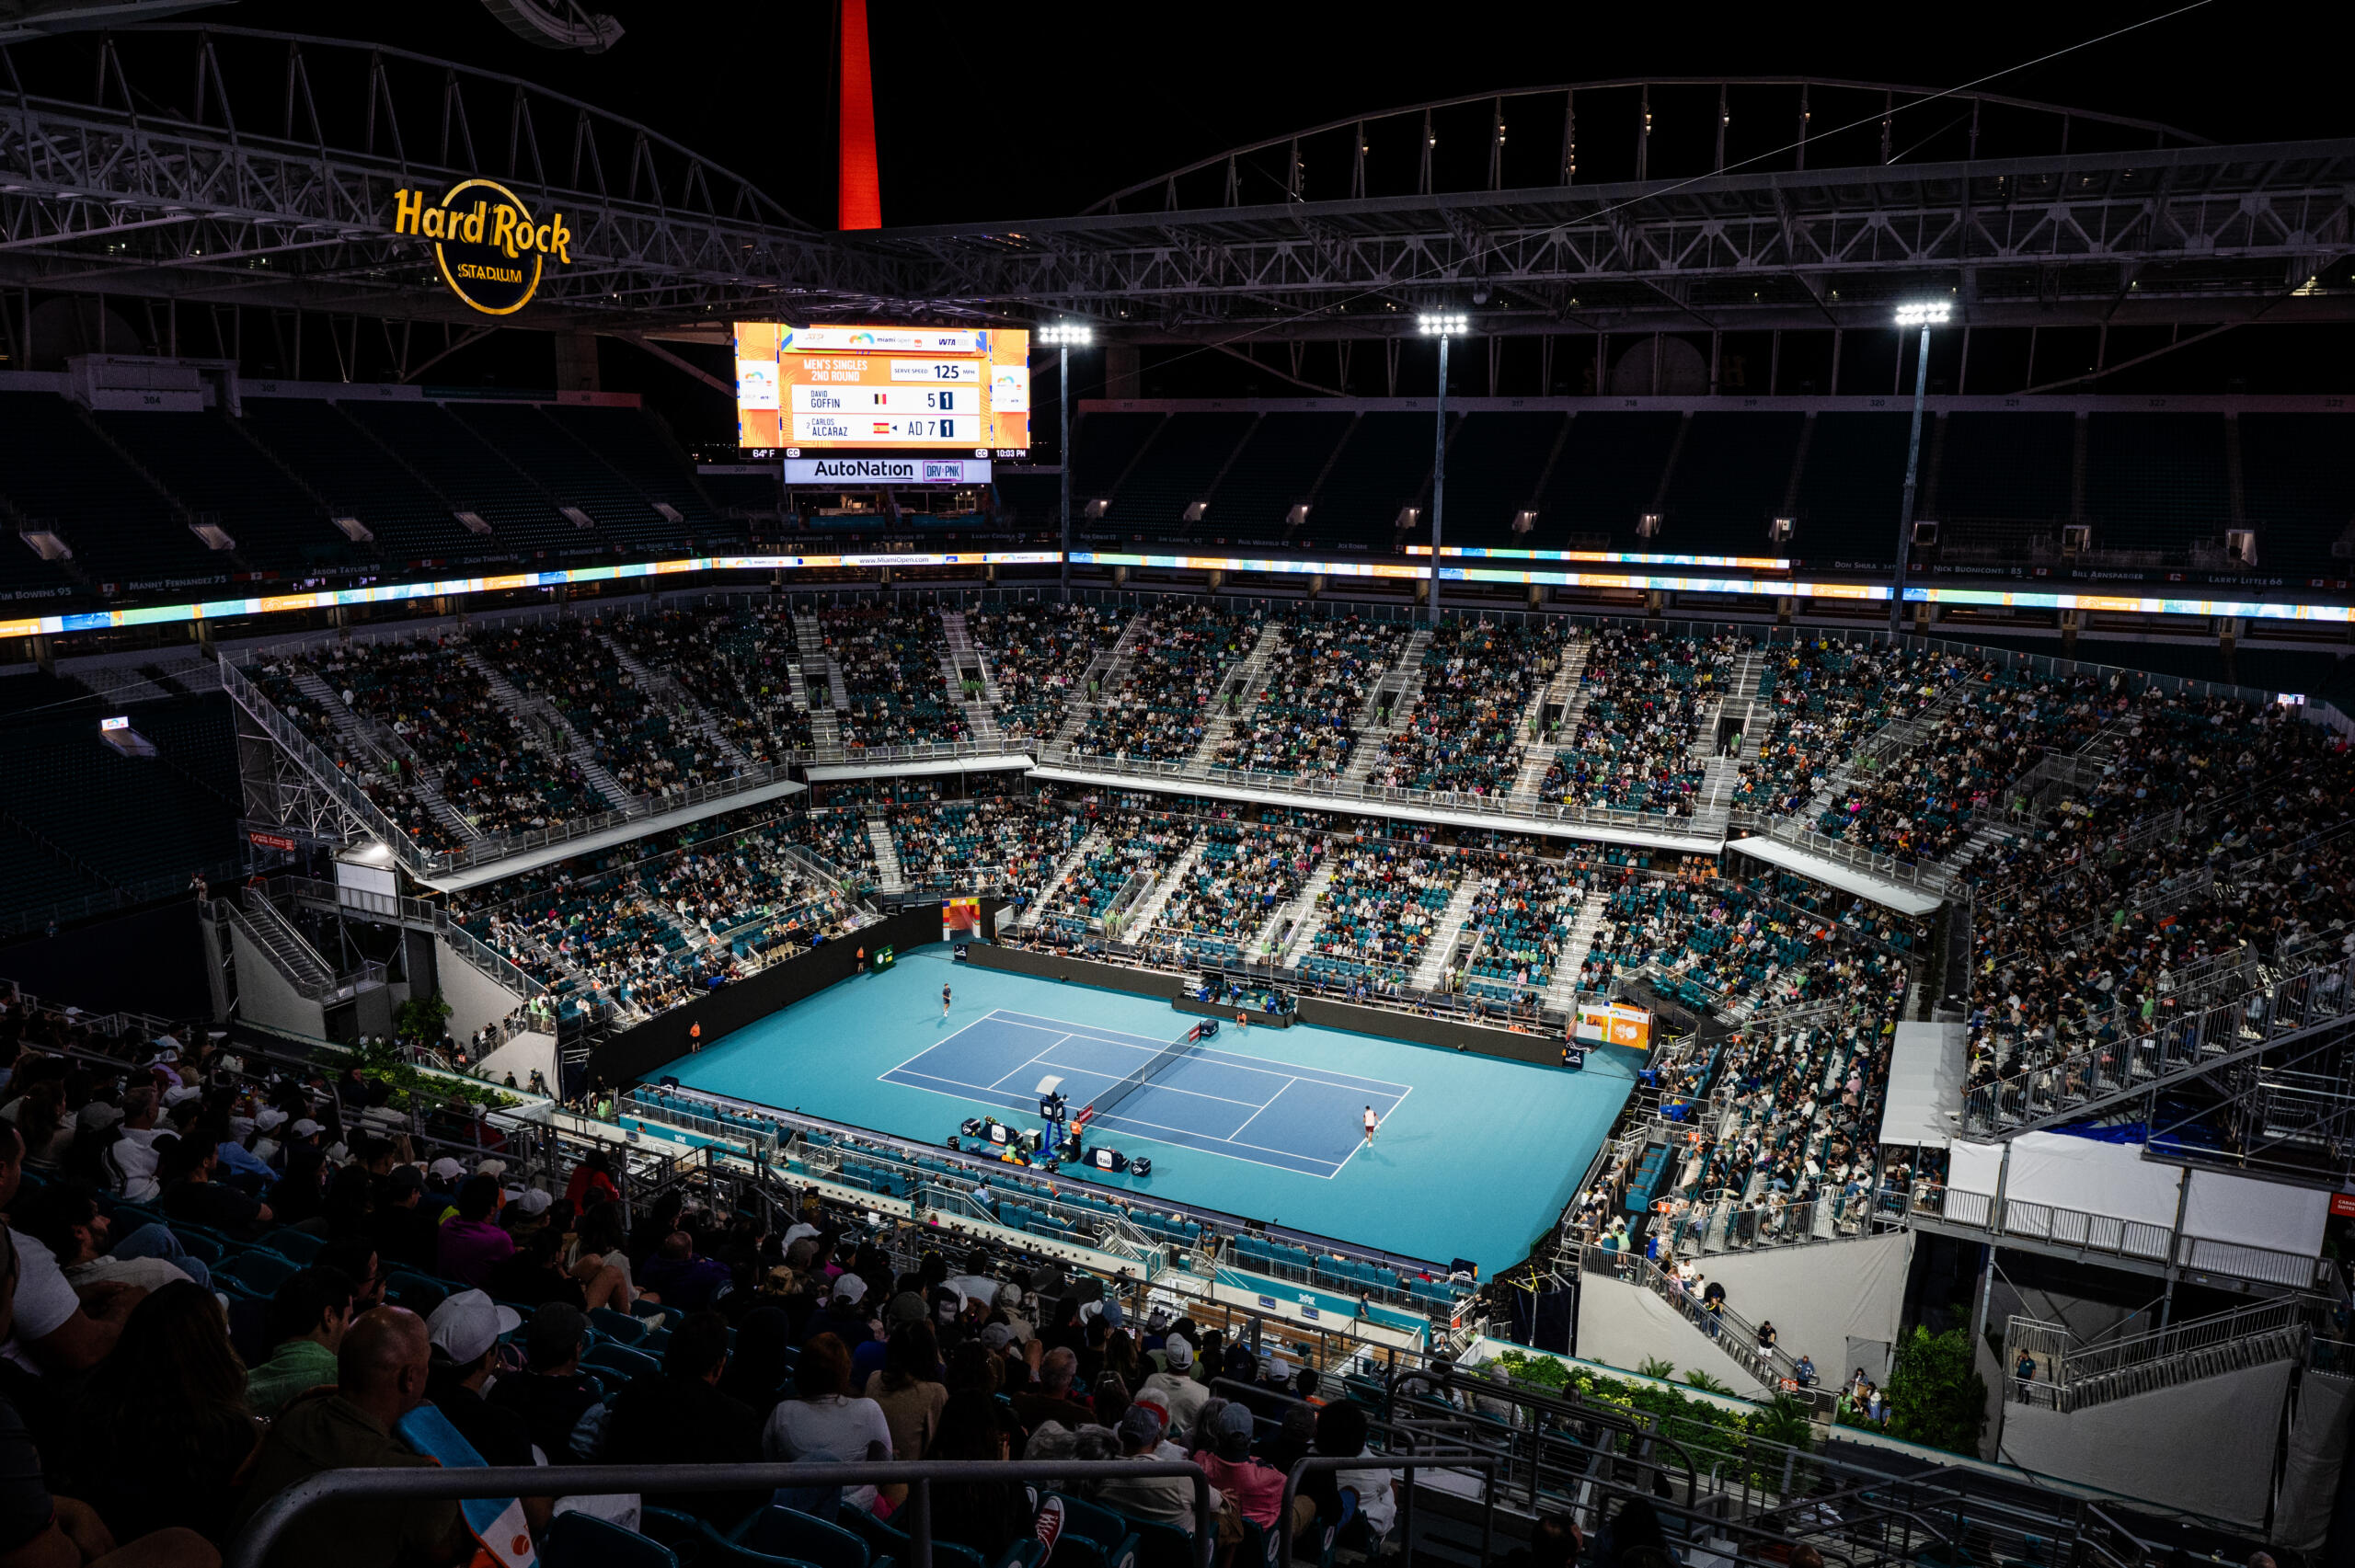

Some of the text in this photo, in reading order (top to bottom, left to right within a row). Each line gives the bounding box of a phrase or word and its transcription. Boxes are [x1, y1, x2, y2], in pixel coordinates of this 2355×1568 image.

[394, 188, 571, 264] Hard Rock
[458, 263, 522, 284] STADIUM
[803, 359, 868, 372] MEN'S SINGLES
[811, 370, 860, 382] 2ND ROUND
[934, 364, 959, 379] 125
[260, 383, 277, 393] 305
[810, 390, 828, 398] DAVID
[143, 395, 161, 406] 304
[810, 398, 841, 408] GOFFIN
[927, 393, 936, 407] 5
[1869, 399, 1885, 407] 320
[2148, 399, 2165, 407] 322
[811, 418, 835, 426] CARLOS
[806, 421, 848, 437] 2 ALCARAZ
[908, 420, 923, 436] AD
[927, 421, 936, 436] 7
[769, 449, 775, 458] F
[787, 449, 799, 457] CC
[814, 460, 913, 476] AutoNation
[926, 464, 959, 477] DRV PNK
[859, 555, 929, 565] www.MiamiOpen.com
[339, 566, 368, 574] TAYLOR
[1954, 566, 2004, 575] BUONICONTI
[2072, 569, 2143, 580] BILL ARNSPARGER
[129, 574, 226, 590] MANNY FERNANDEZ 75
[2208, 574, 2282, 586] LARRY LITTLE 66
[15, 589, 56, 600] BOWENS
[57, 587, 72, 596] 95
[993, 1129, 1005, 1139] itaú
[1097, 1155, 1110, 1165] itaú
